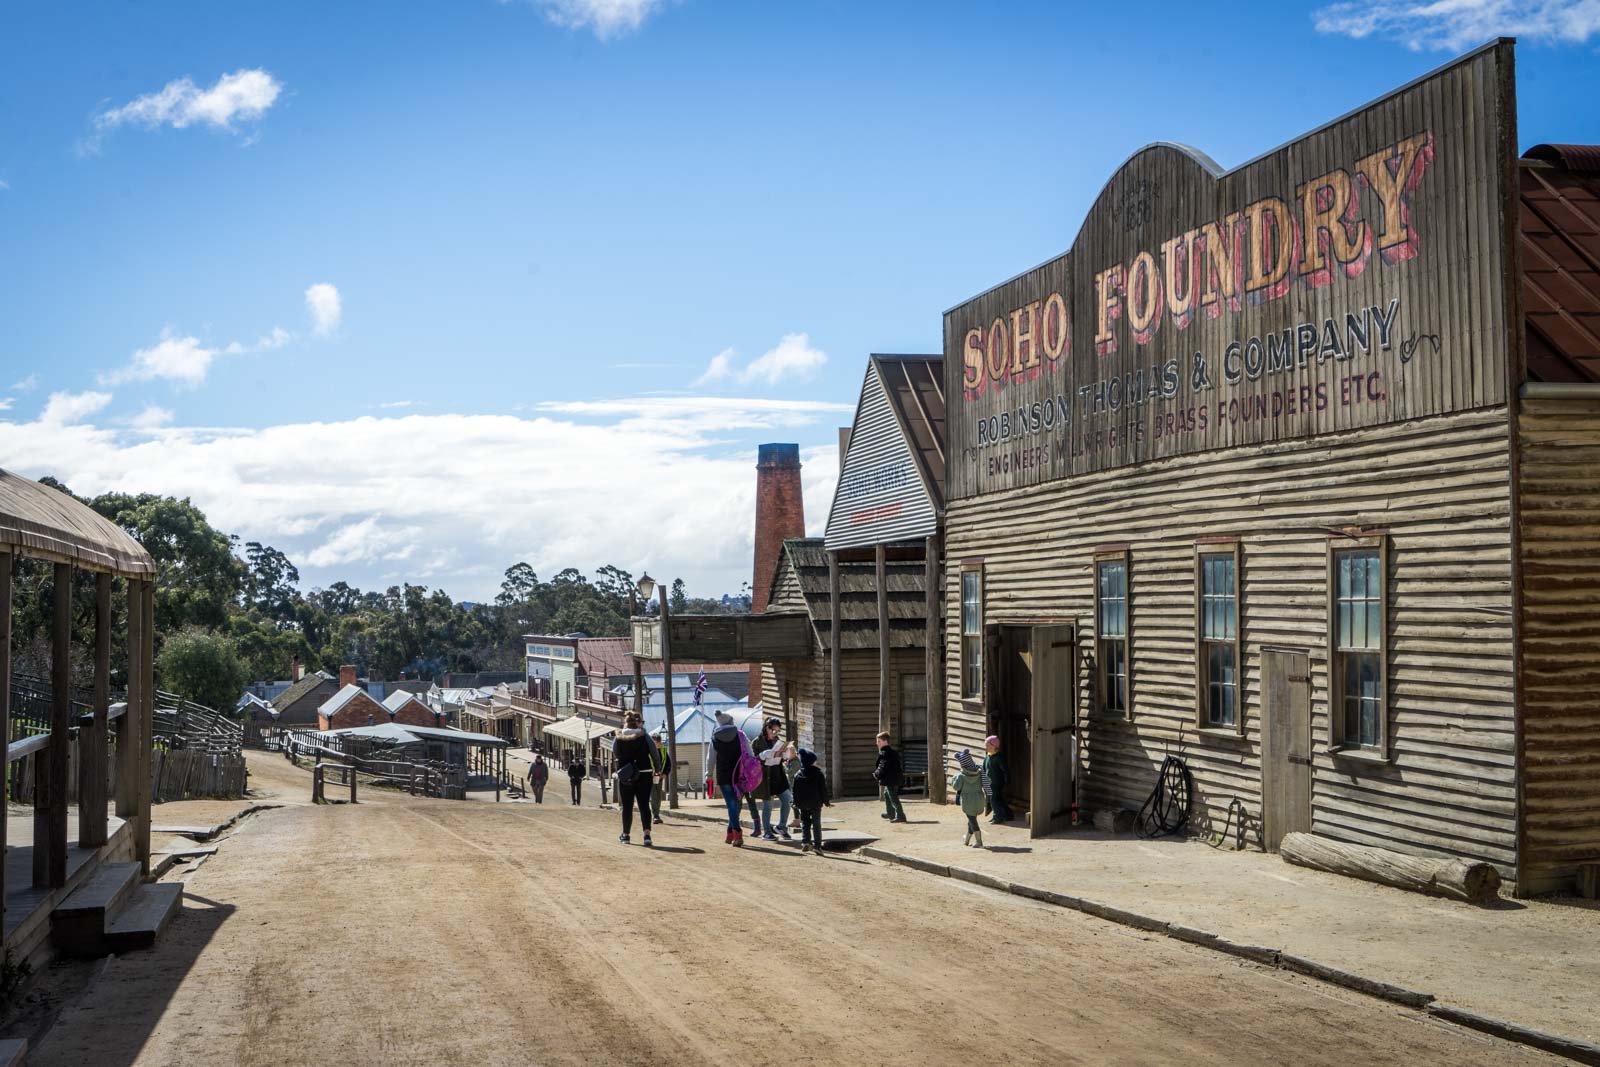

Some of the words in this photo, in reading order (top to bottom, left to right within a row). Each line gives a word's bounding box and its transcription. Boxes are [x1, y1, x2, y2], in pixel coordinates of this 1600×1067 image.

[964, 293, 1071, 401] SOHO
[1095, 131, 1436, 355] FOUNDRY
[978, 394, 1070, 447] ROBINSON
[1079, 359, 1179, 418] THOMAS
[1191, 352, 1213, 392] &
[1225, 298, 1399, 384] COMPANY
[989, 443, 1050, 476] ENGINEERS
[1056, 418, 1144, 460] MLLWRGHTS
[1155, 405, 1208, 439] BRASS
[1217, 382, 1327, 427] FOUNDERS
[1341, 371, 1386, 406] ETC.
